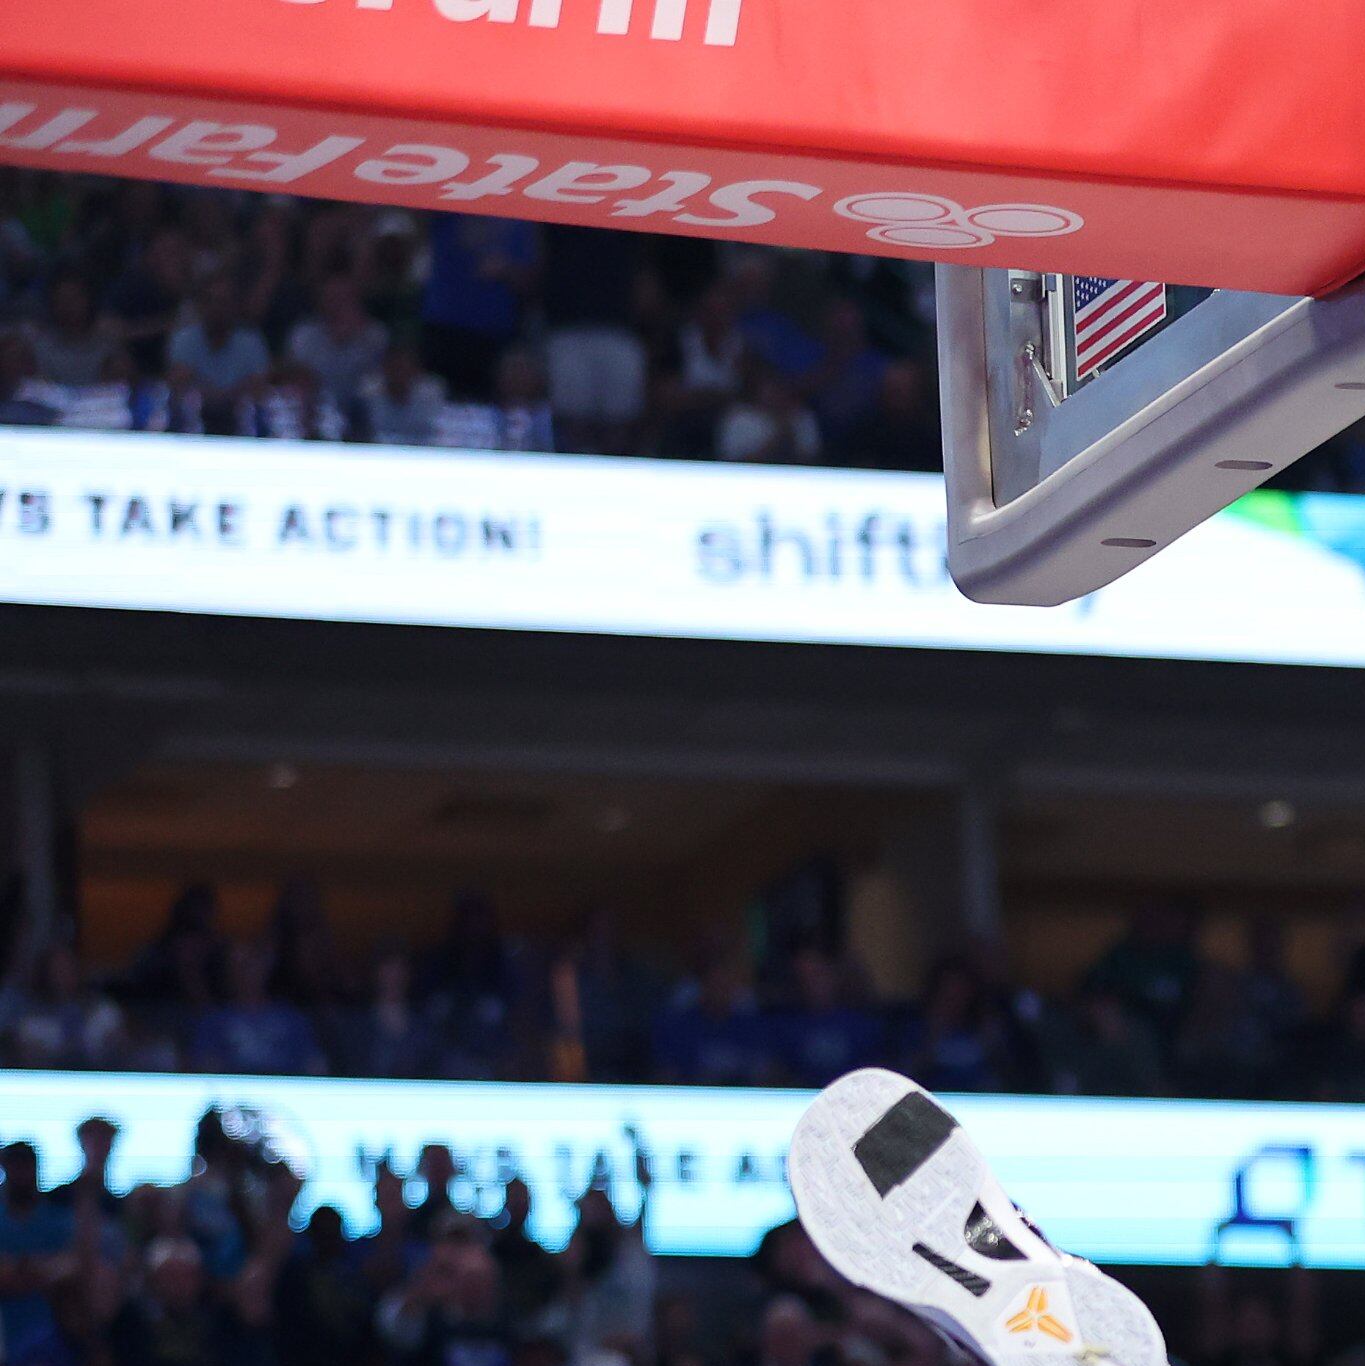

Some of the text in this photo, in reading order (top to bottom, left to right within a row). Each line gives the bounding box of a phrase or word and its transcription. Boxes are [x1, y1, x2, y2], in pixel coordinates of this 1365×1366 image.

[354, 143, 820, 229] State
[84, 493, 244, 545] TAKE
[279, 502, 544, 562] ACTION!
